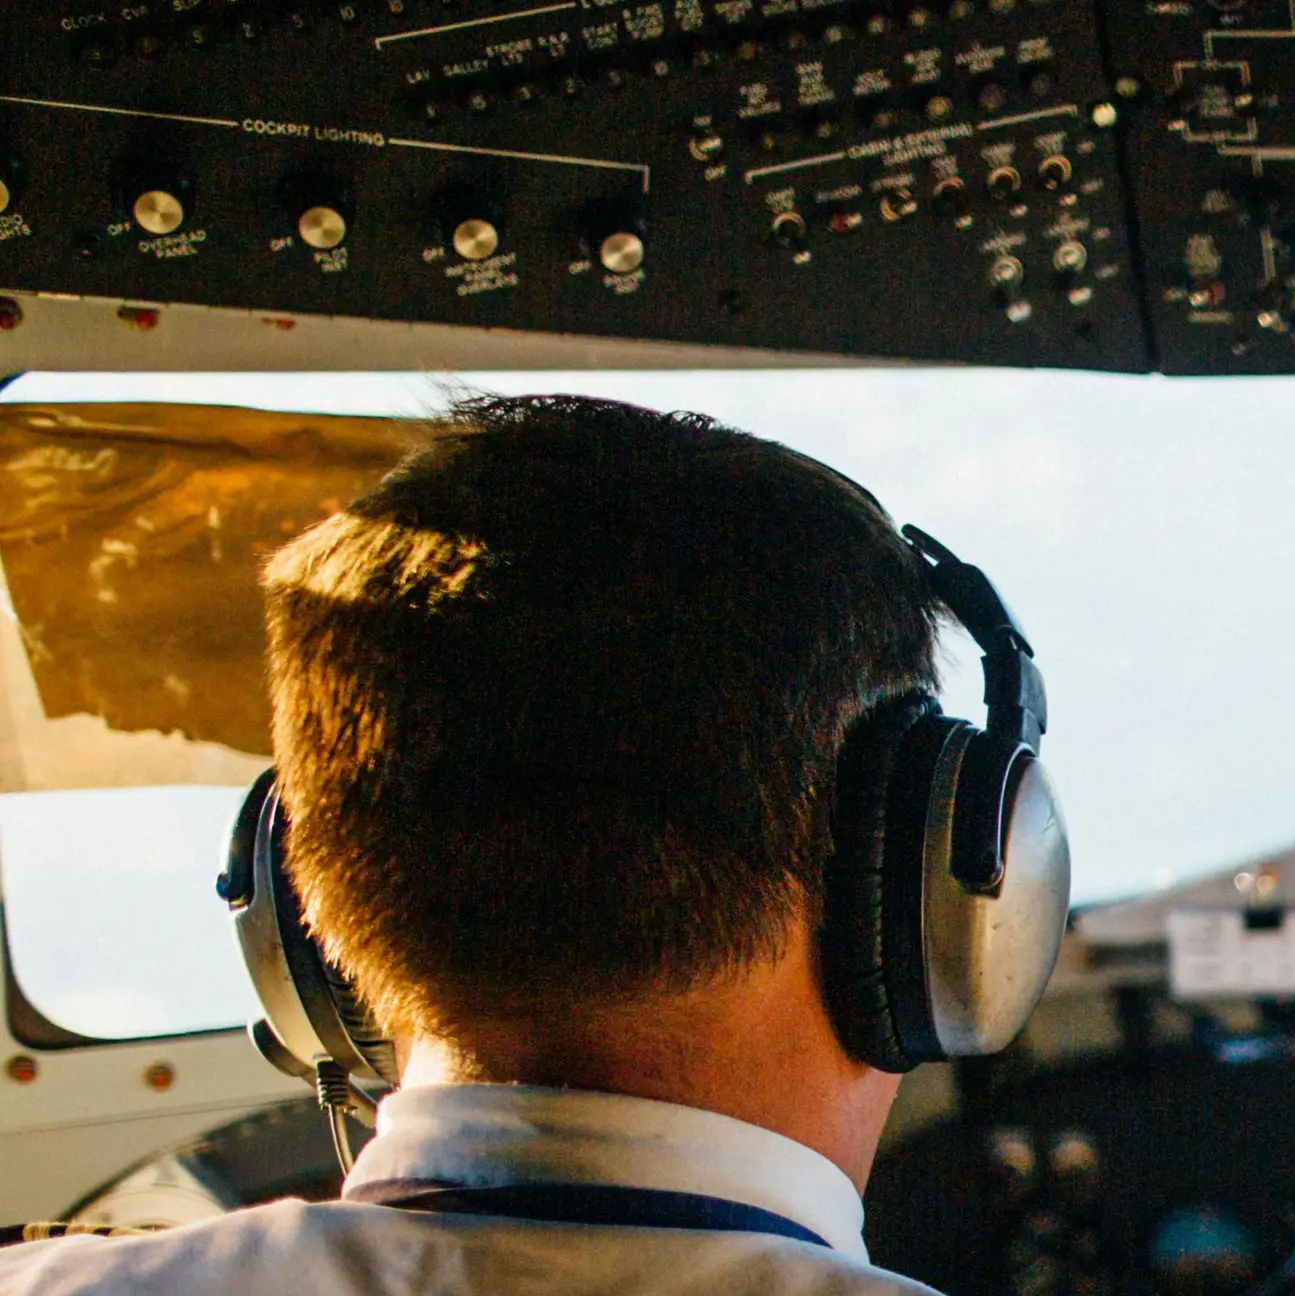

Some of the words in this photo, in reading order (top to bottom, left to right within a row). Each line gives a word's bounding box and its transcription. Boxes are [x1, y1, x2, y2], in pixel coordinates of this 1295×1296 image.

[60, 13, 107, 31] CLOCK
[242, 118, 311, 138] COCKPIT
[314, 126, 385, 147] LIGHTING
[107, 220, 132, 236] OFF
[138, 229, 207, 253] OVERHEAD
